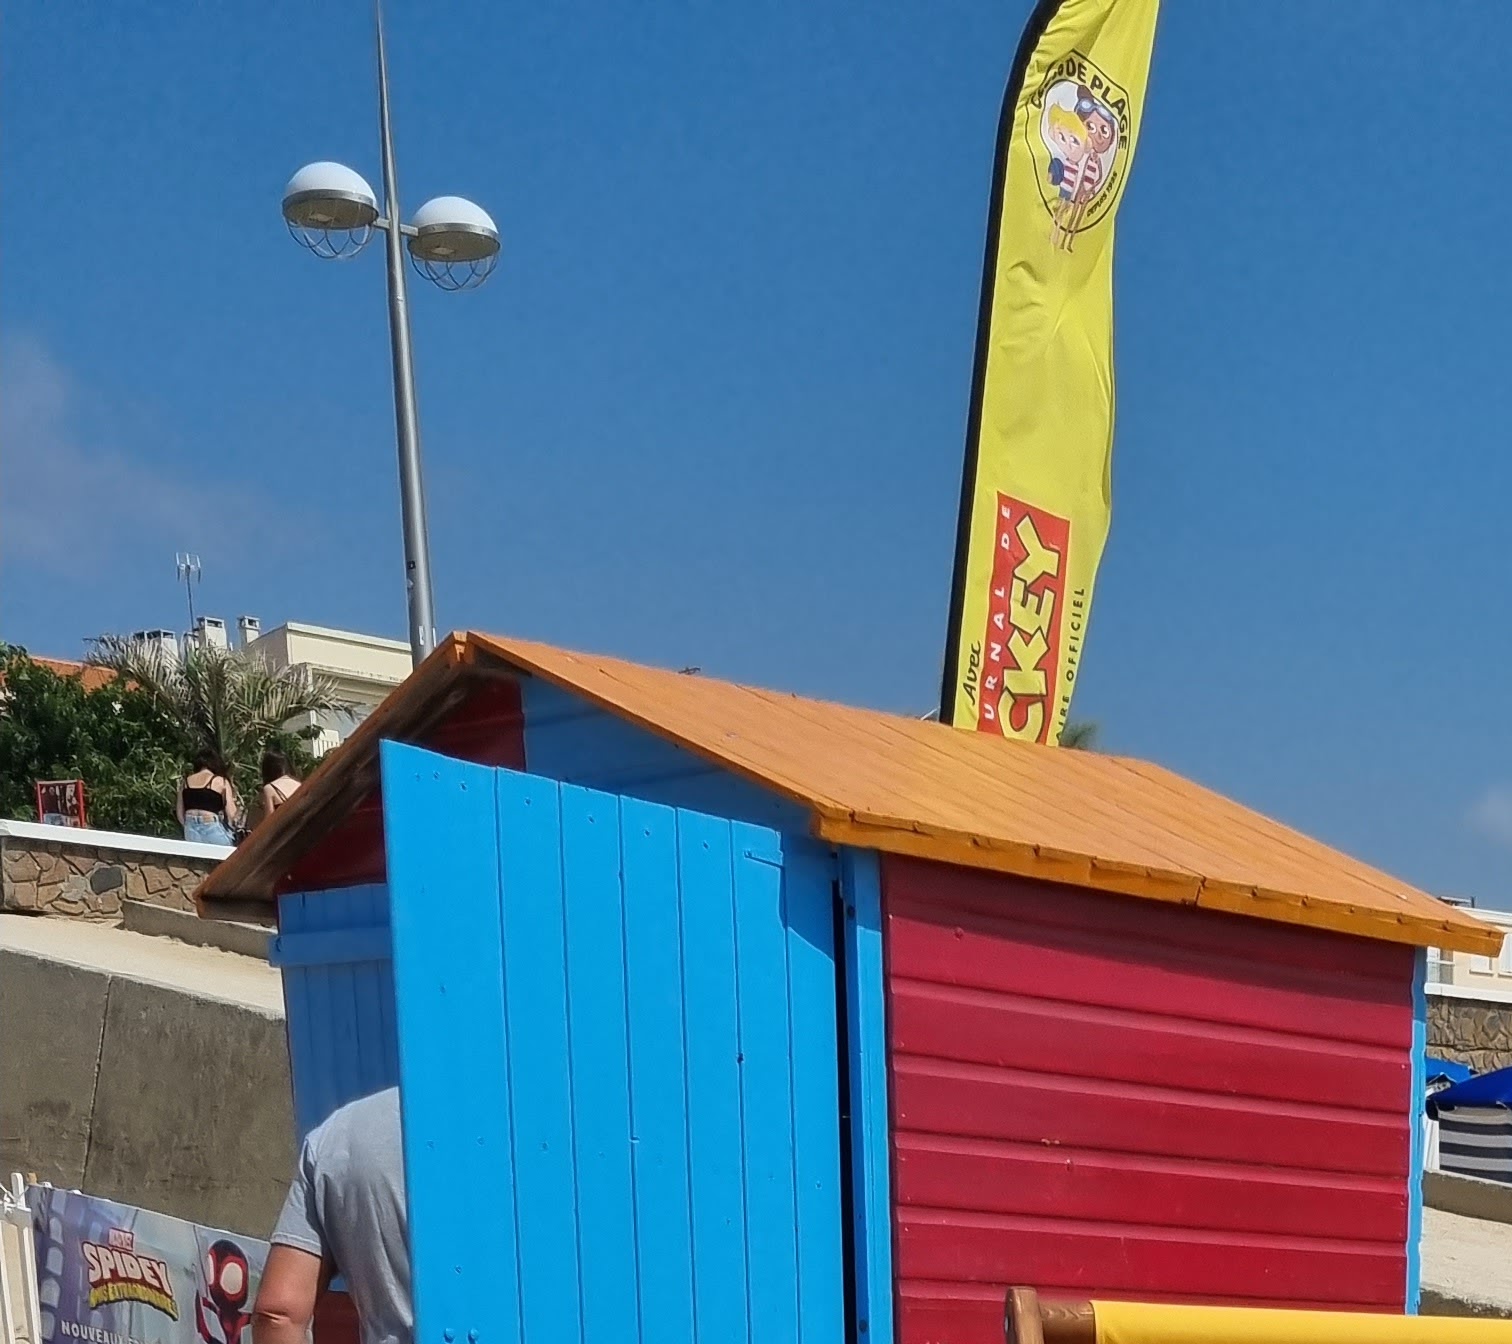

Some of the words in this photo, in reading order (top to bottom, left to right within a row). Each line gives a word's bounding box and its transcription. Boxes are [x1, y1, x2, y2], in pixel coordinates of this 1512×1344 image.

[1089, 74, 1128, 150] PLAGE
[1001, 504, 1011, 550] DE
[1066, 588, 1085, 682] OFFICIEL
[963, 640, 981, 706] Avec
[82, 1241, 173, 1299] SPIDEY
